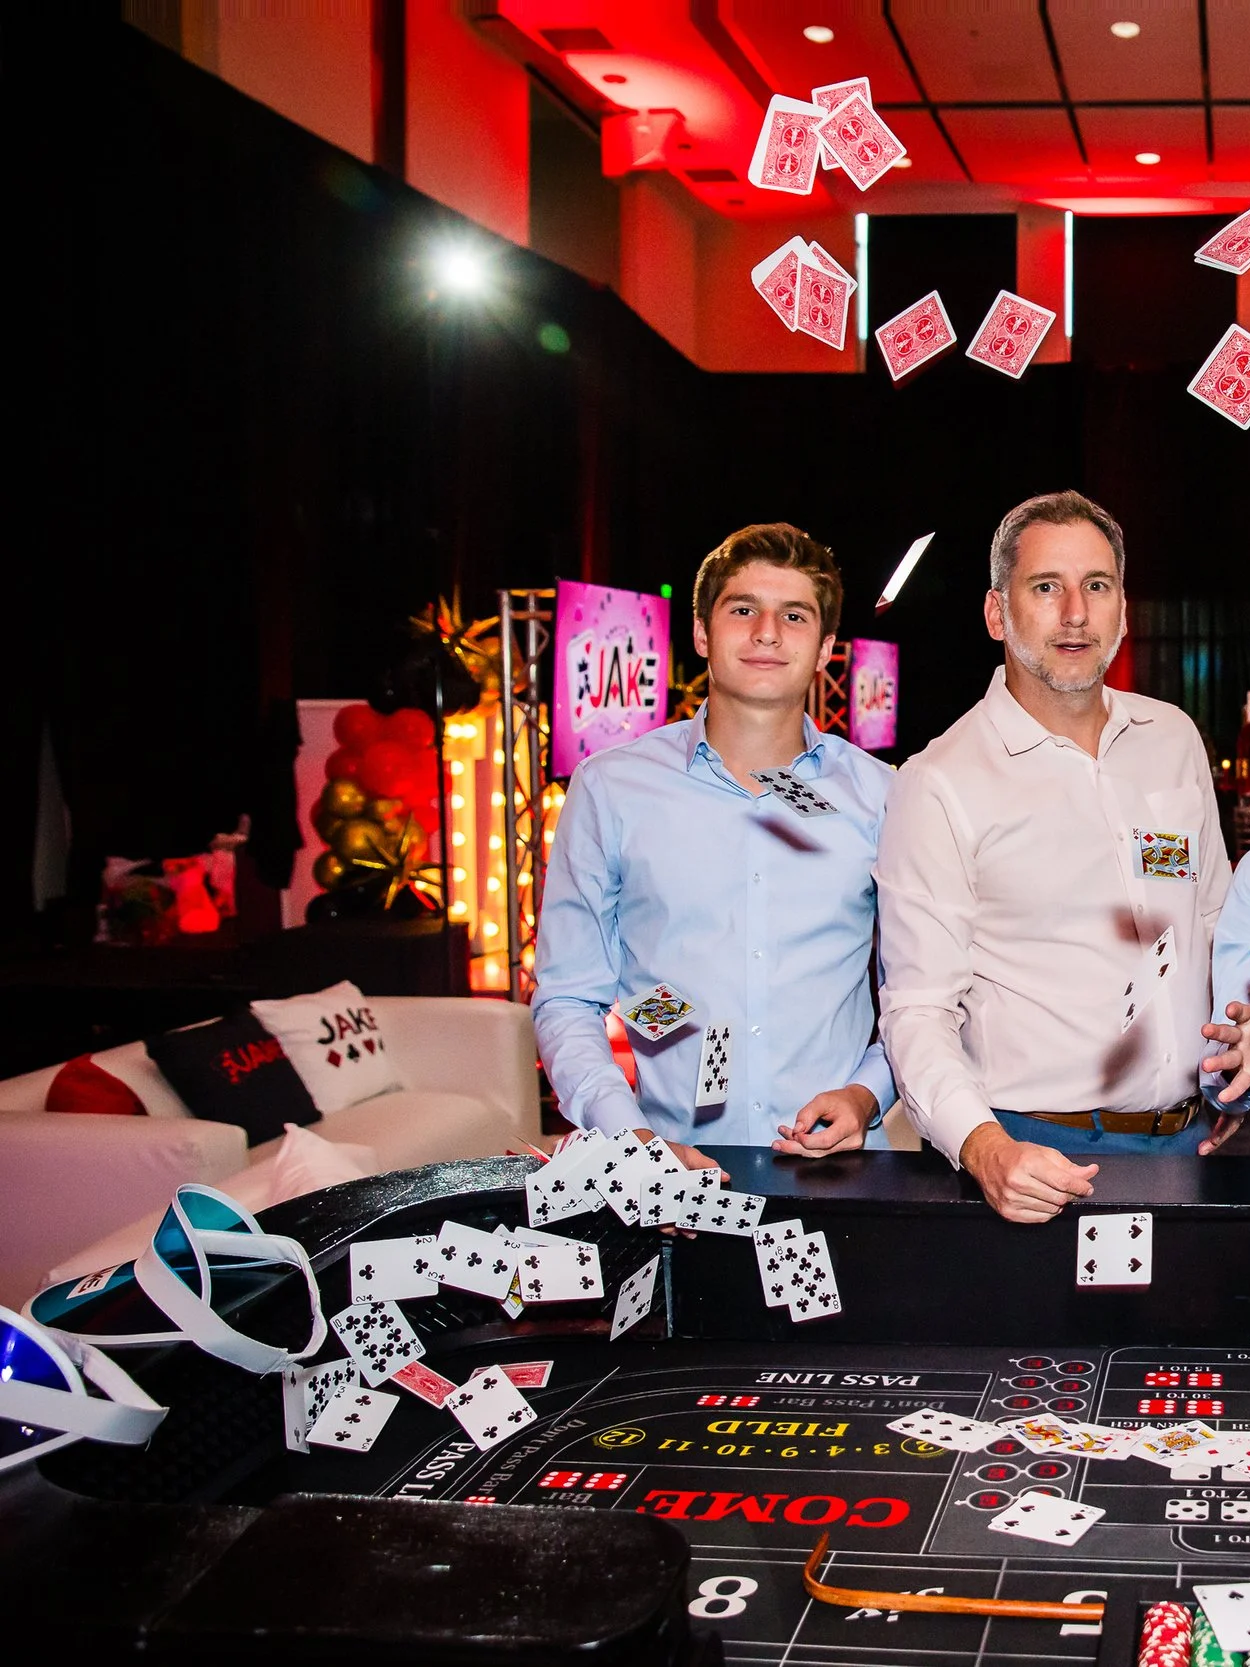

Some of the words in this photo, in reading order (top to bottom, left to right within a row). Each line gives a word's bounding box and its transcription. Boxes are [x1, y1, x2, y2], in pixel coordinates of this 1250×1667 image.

[589, 645, 658, 709] JAKE
[587, 1129, 598, 1139] 2
[755, 1371, 835, 1386] LINE
[840, 1373, 921, 1387] PASS
[773, 1397, 816, 1407] Bar
[821, 1397, 874, 1409] Pass
[706, 1419, 851, 1438] FIELD
[601, 1430, 644, 1446] 12
[415, 1441, 477, 1481] PASS
[542, 1491, 595, 1504] Bar
[1201, 1488, 1230, 1499] TO
[636, 1489, 911, 1529] COME
[687, 1575, 759, 1619] 8
